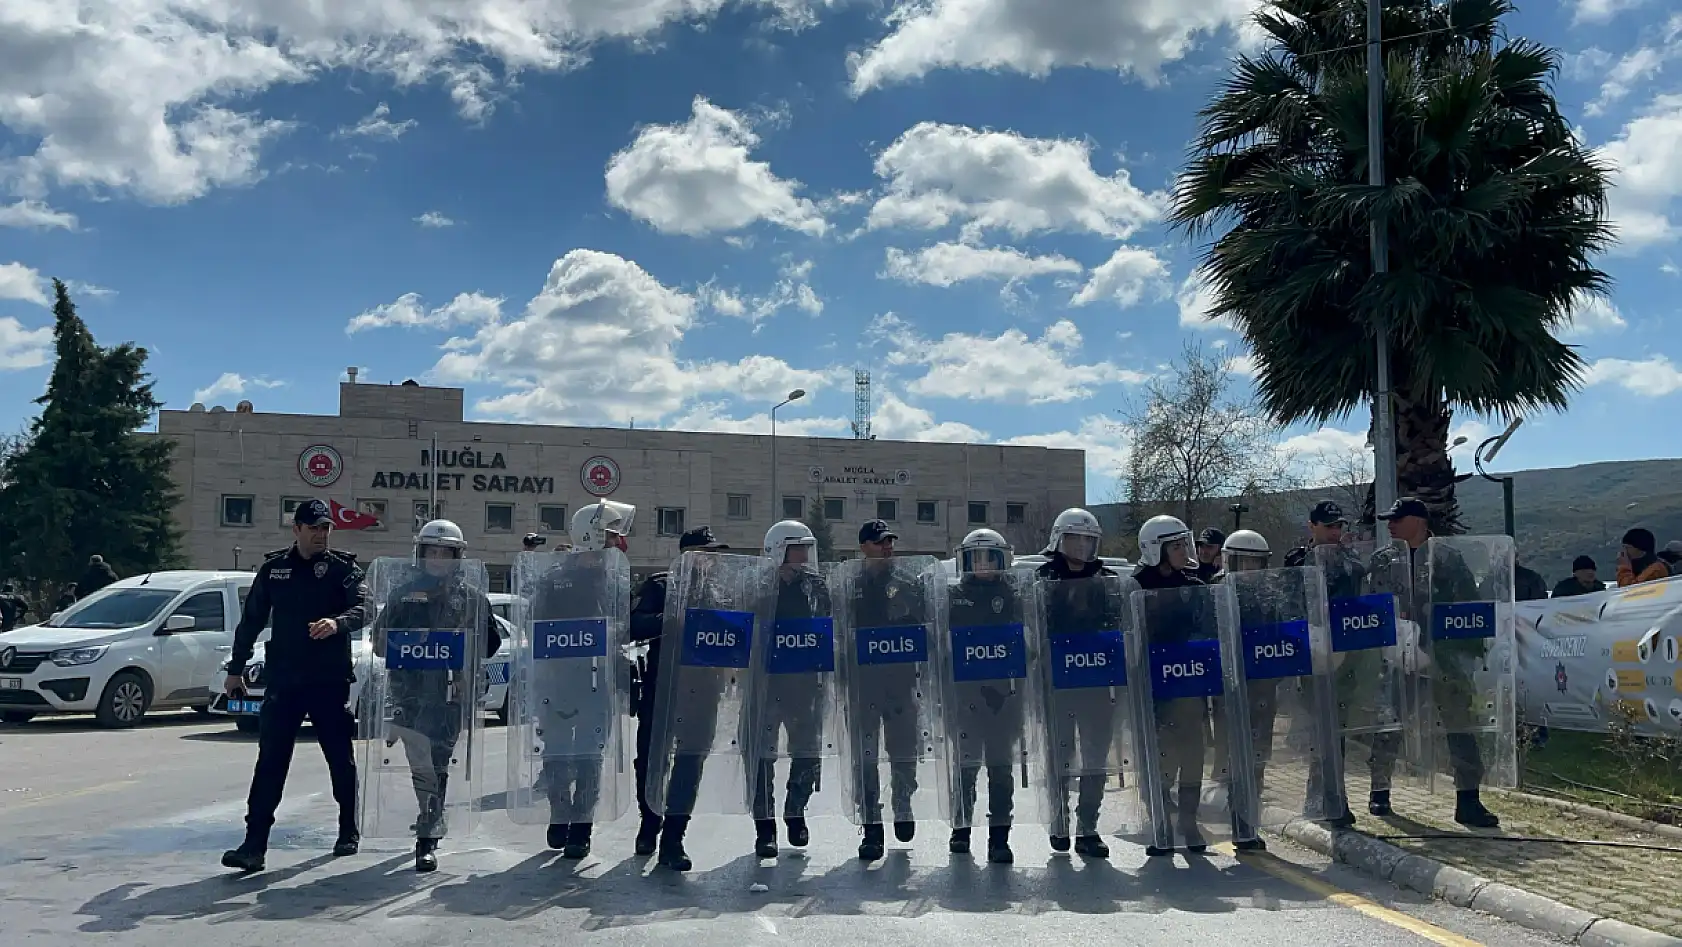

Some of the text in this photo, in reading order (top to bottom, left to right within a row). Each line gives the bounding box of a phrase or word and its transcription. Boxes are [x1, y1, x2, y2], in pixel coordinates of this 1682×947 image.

[420, 446, 506, 469] MUĞLA
[371, 471, 554, 494] ADALET SARAYI
[1343, 613, 1380, 631] POLİS
[1445, 612, 1484, 630] POLİS
[546, 630, 594, 648] POLİS
[696, 629, 736, 647] POLİS
[776, 633, 817, 649] POLİS
[869, 637, 914, 654] POLİS
[401, 642, 450, 659] POLİS
[966, 645, 1007, 661] POLİS
[1254, 640, 1295, 659] POLİS
[1065, 652, 1107, 668] POLİS
[1162, 659, 1205, 679] POLİS
